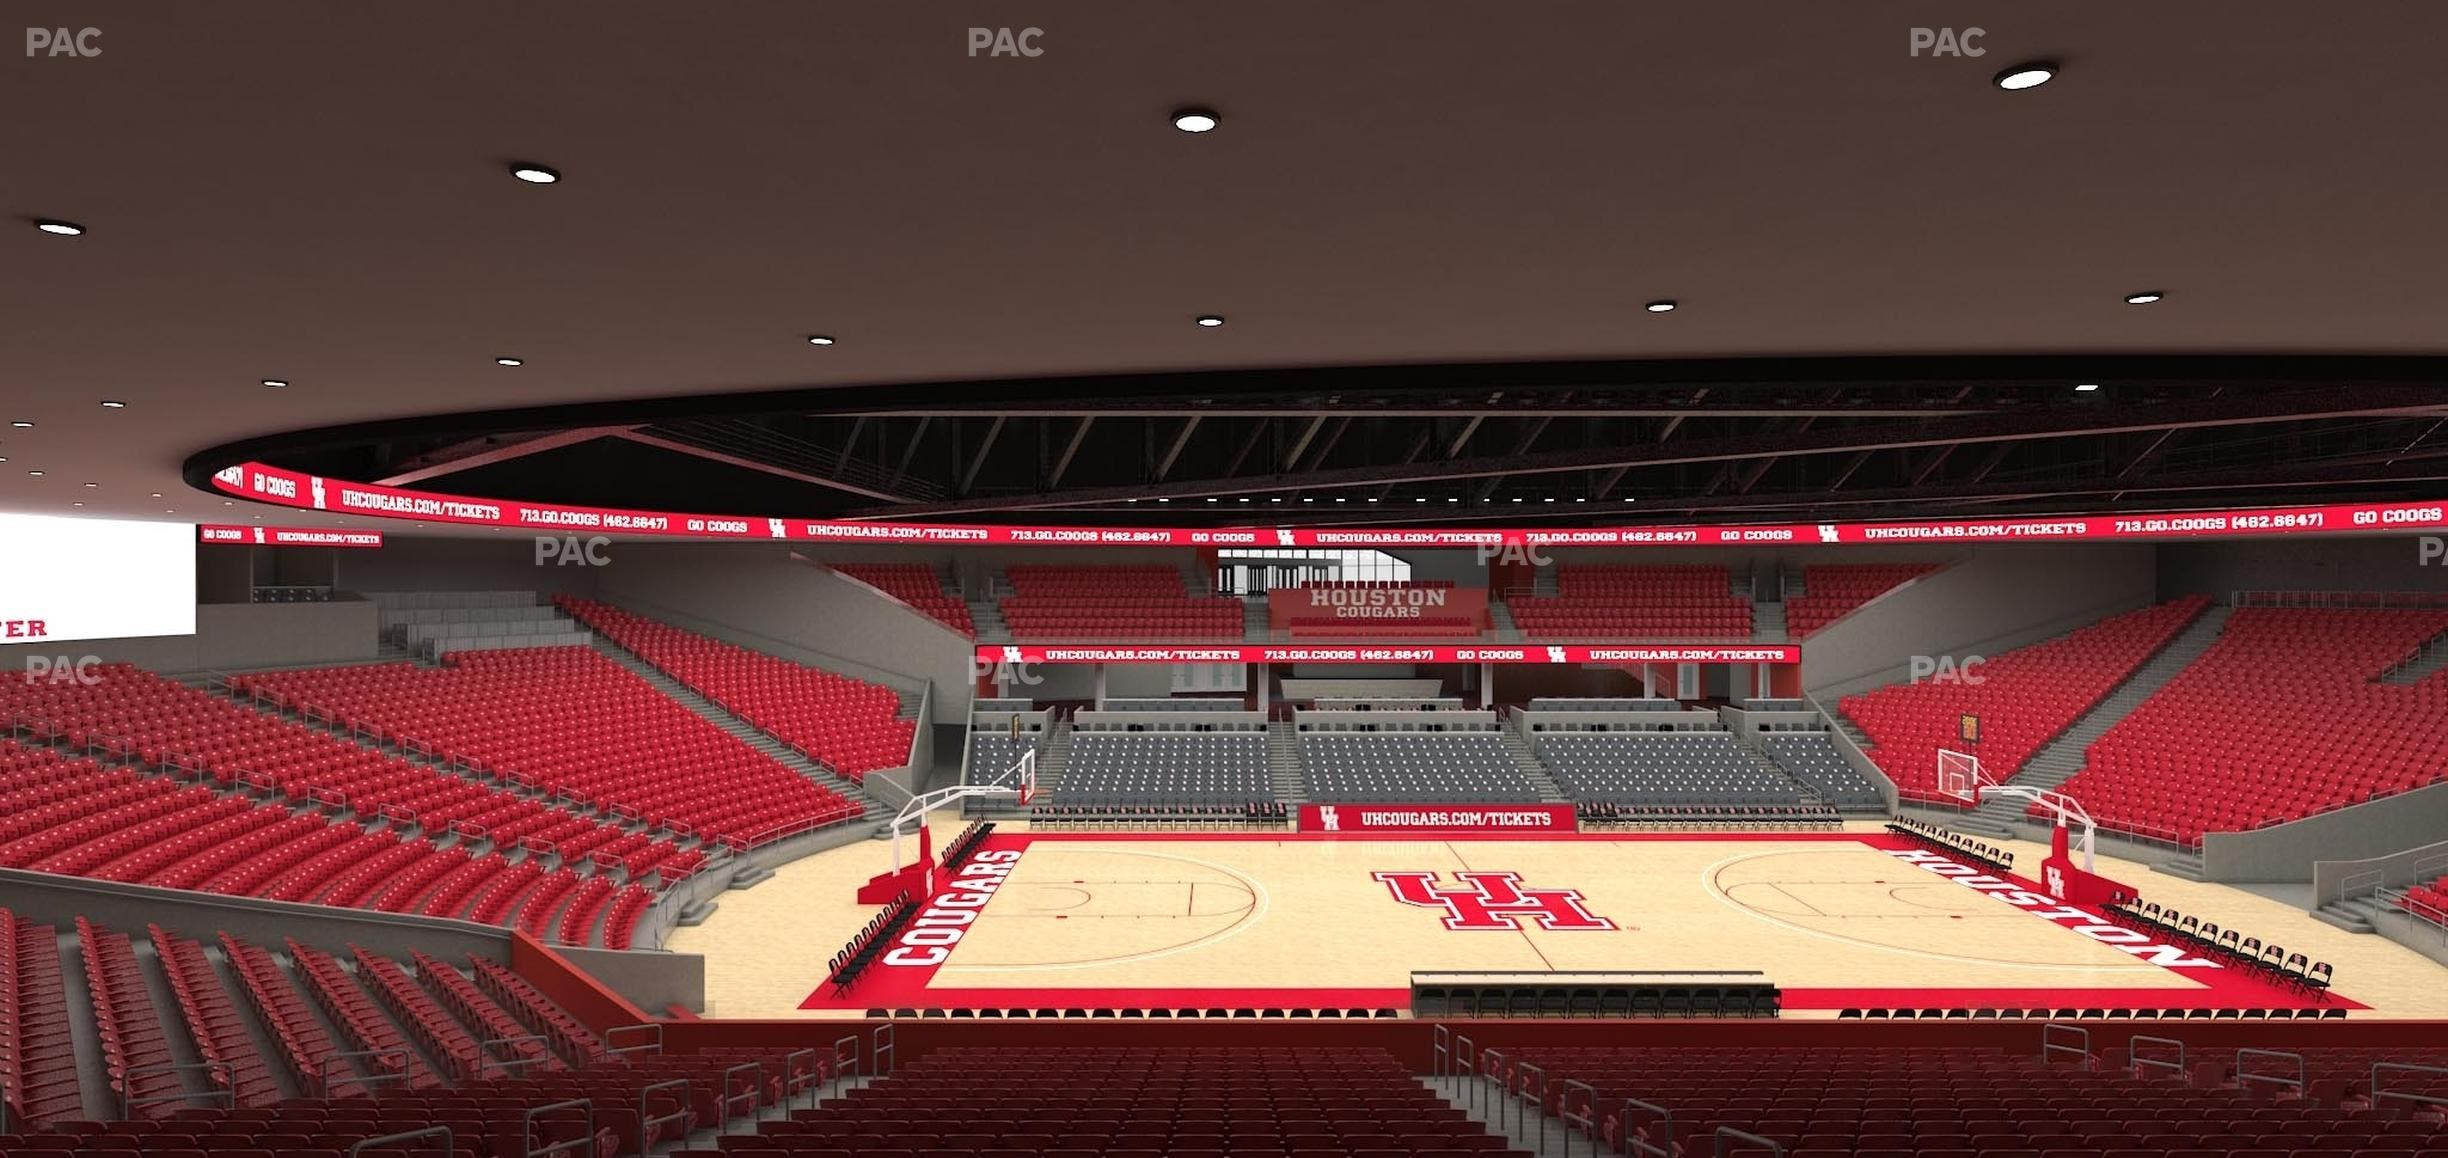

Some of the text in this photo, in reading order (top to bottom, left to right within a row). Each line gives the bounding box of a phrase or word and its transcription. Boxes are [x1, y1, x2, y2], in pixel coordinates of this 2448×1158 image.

[342, 489, 501, 520] UHCOUGARS.COM/TICKETS
[687, 519, 705, 532] GO
[707, 520, 748, 533] COOGS
[807, 524, 988, 540] UHCOUGARS.COM/TICKETS
[1191, 532, 1210, 543] GO
[1316, 533, 1503, 544] UHCOUGARS.COM/TICKETS
[1720, 530, 1741, 541] GO
[1743, 529, 1793, 541] COOGS
[1864, 522, 2087, 539] UHCOUGARS.COM/TICKETS
[2353, 510, 2378, 525] GO
[2382, 507, 2443, 523] COOGS
[1310, 589, 1446, 606] HOUSTON
[1336, 606, 1421, 618] COUGARS
[0, 620, 47, 637] ER
[1045, 650, 1240, 660] UHCOUGARS.COM/TICKETS
[1456, 650, 1476, 660] GO
[1478, 650, 1524, 660] COOGS
[1589, 650, 1785, 660] UHCOUGARS.COM/TICKETS
[1361, 811, 1552, 826] UHCOUGARS.COM/TICKETS
[882, 850, 1023, 966] COUGARS
[1370, 871, 1621, 931] UH
[1883, 849, 2224, 969] HOUSTON
